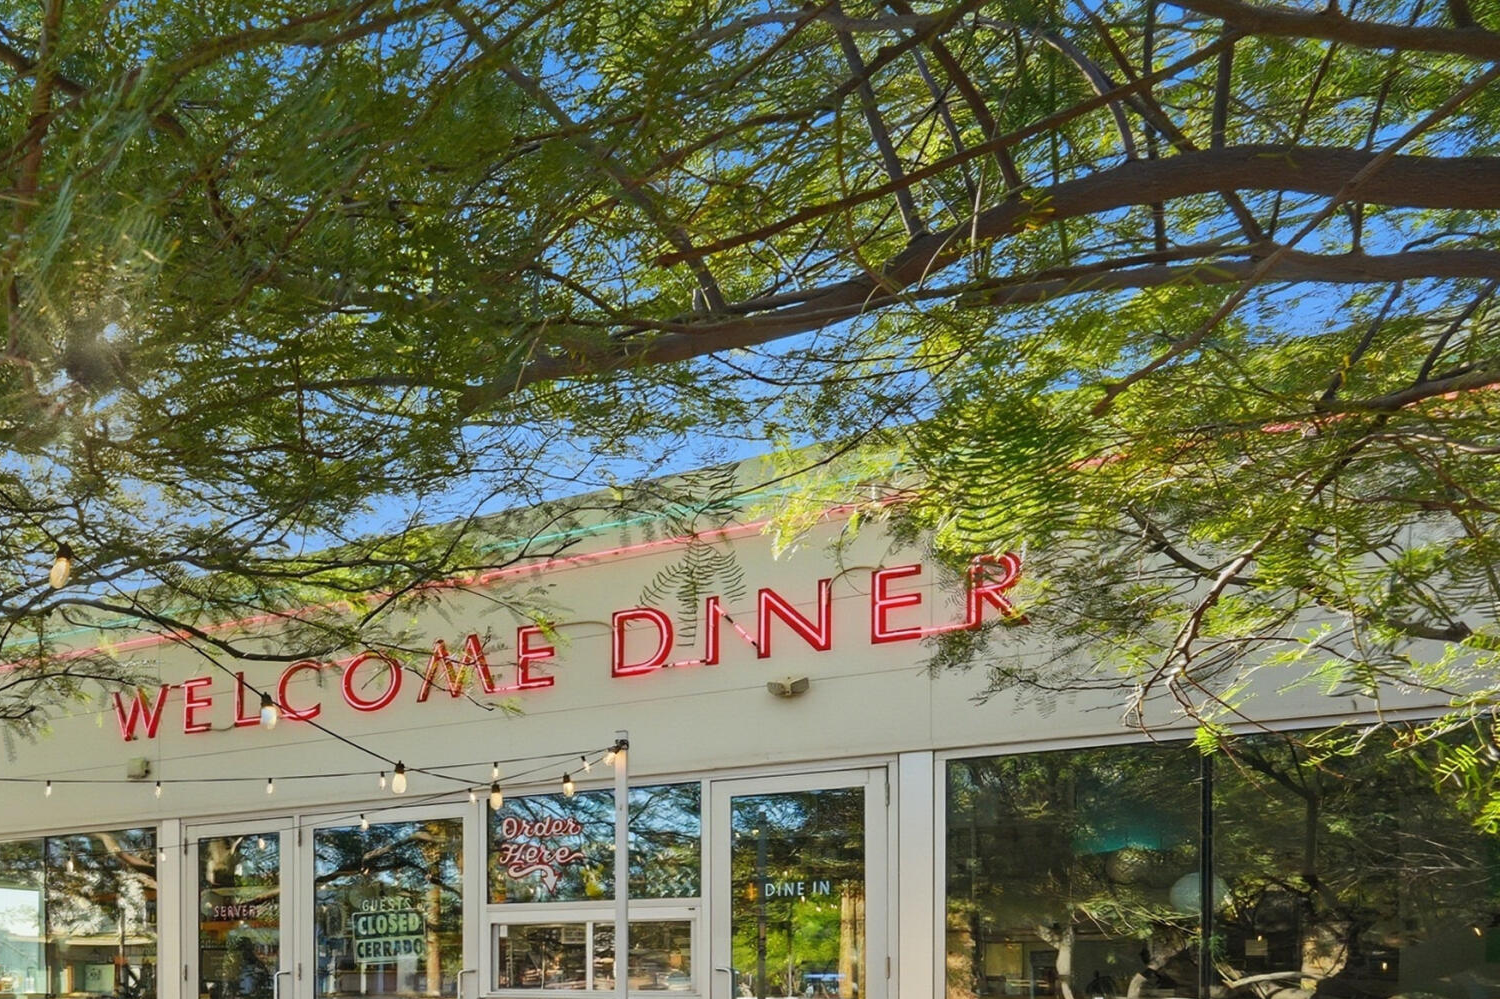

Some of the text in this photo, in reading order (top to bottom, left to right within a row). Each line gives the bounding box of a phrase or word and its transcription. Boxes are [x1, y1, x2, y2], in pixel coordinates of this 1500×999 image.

[112, 551, 1030, 742] WELCOME DINER
[501, 815, 583, 839] Order
[499, 842, 585, 864] Here
[764, 880, 831, 897] DINE IN
[361, 896, 412, 912] GUESTS
[357, 912, 421, 935] CLOSED
[356, 938, 423, 959] CERRADO
